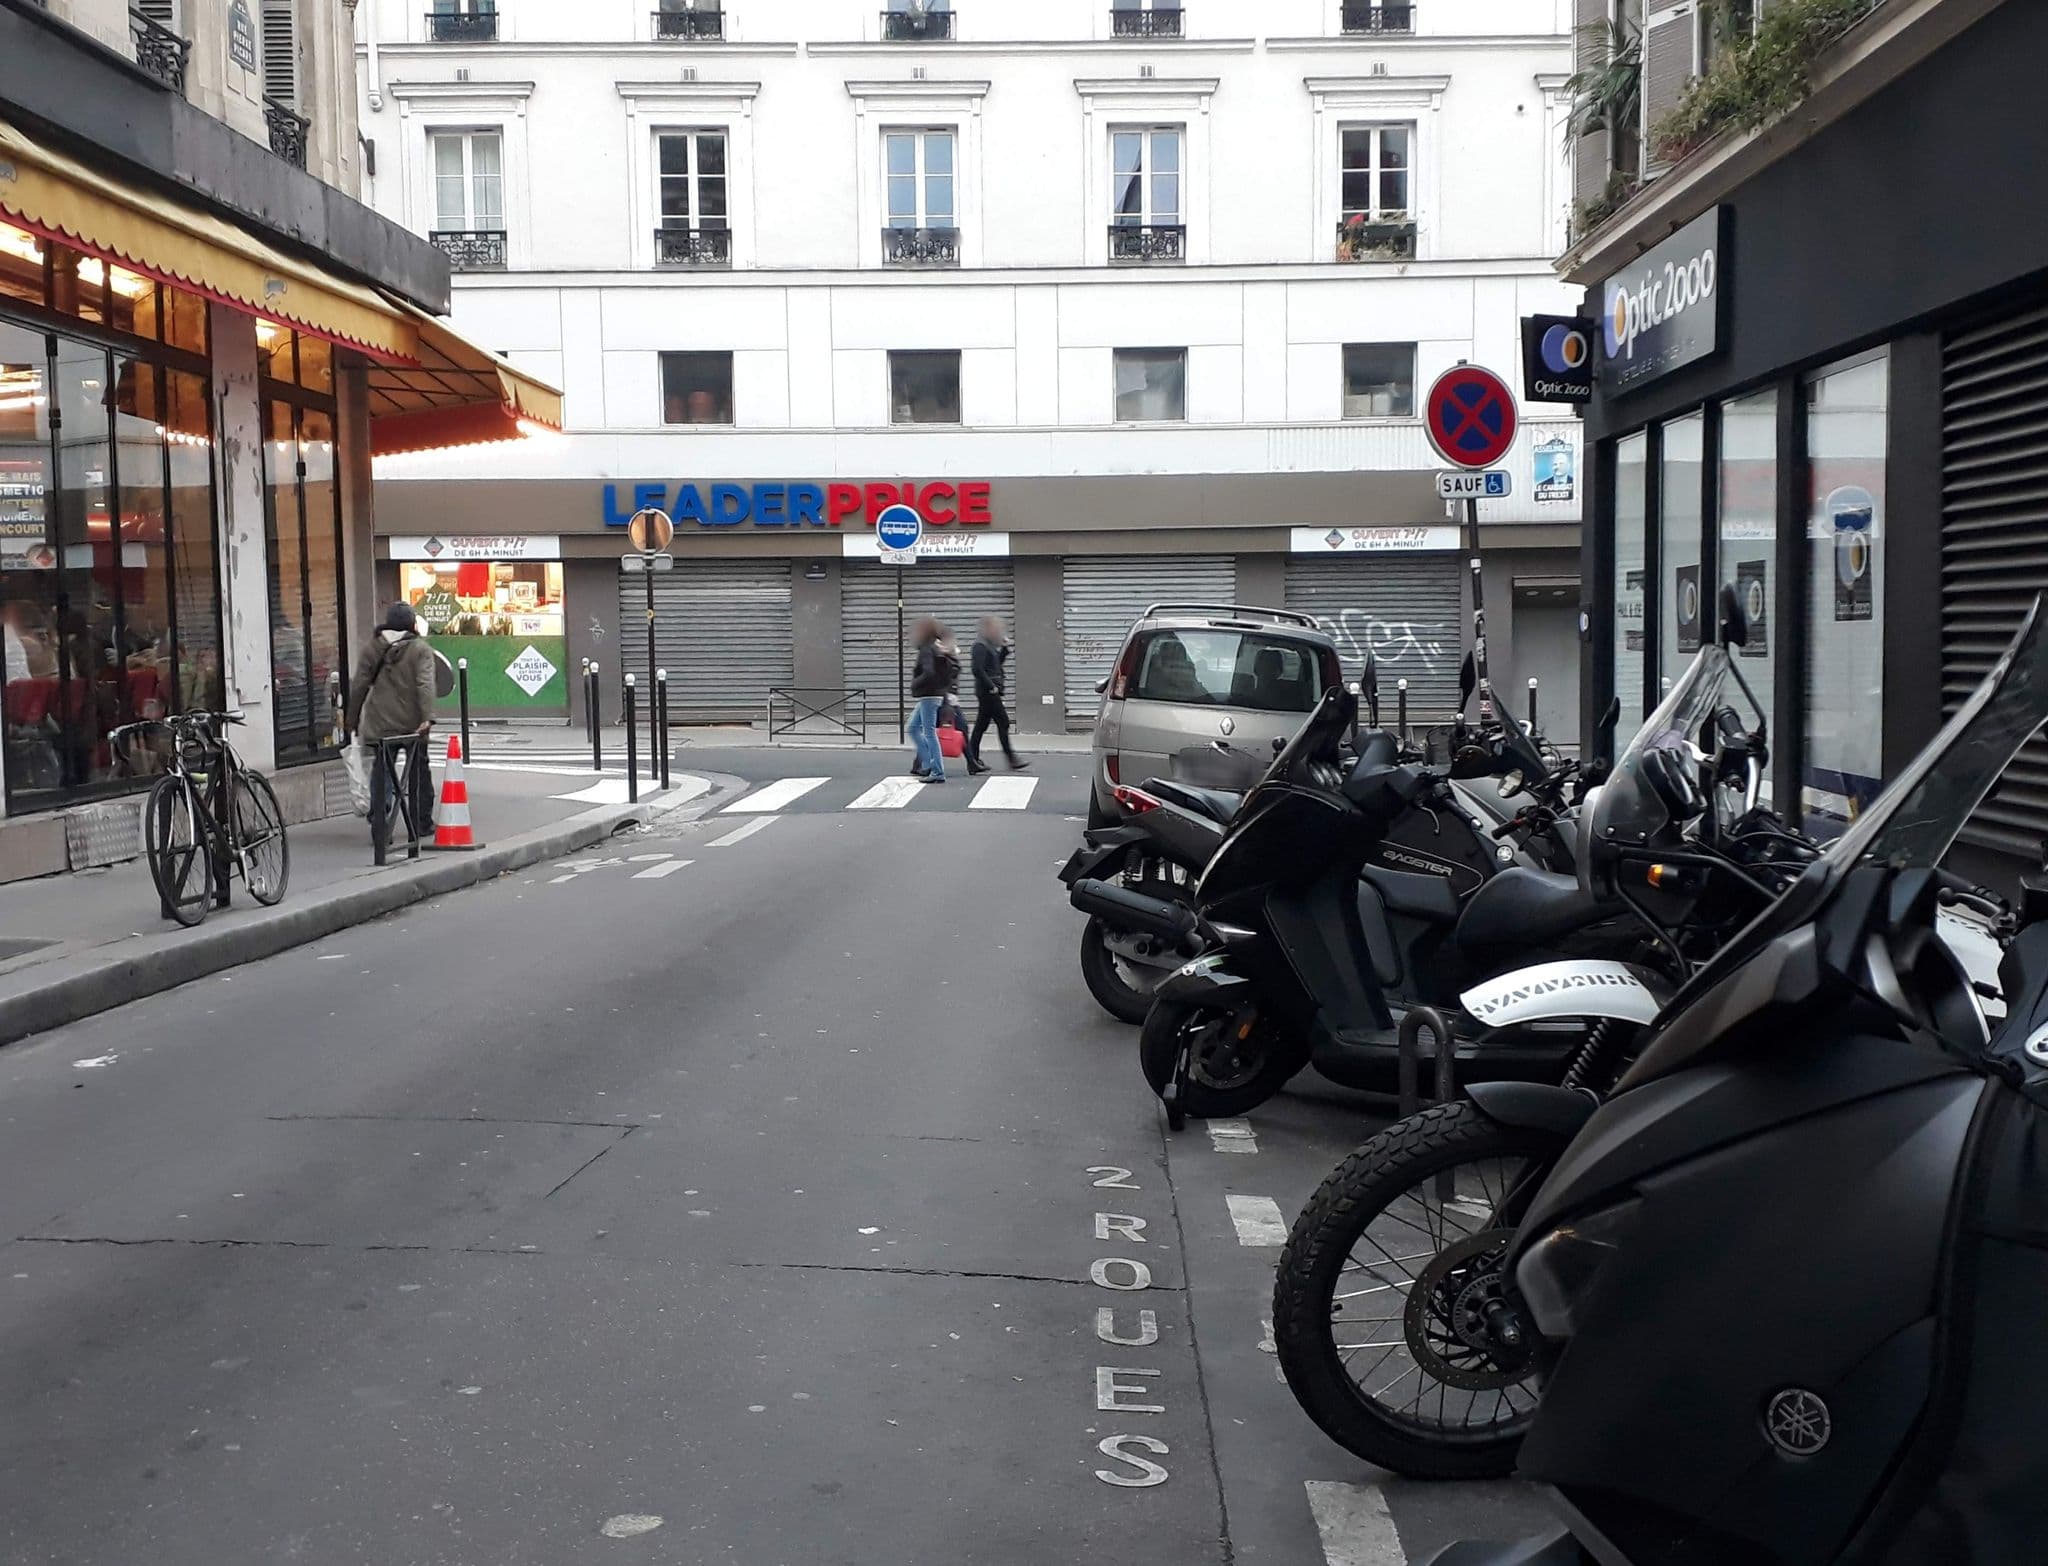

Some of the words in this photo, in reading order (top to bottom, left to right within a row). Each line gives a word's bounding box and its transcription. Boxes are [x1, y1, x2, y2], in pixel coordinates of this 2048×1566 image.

[1614, 270, 1663, 360] Optic
[1663, 249, 1716, 320] 2000
[1534, 380, 1564, 397] Optic
[1564, 382, 1590, 396] 2000
[1443, 478, 1483, 492] SAUF
[1351, 528, 1402, 540] OUVERT
[450, 536, 501, 549] OUVERT
[1354, 541, 1367, 549] DE
[1393, 540, 1424, 548] MINUIT
[454, 549, 466, 557] DE
[469, 549, 481, 557] 6H
[492, 548, 525, 557] MINUIT
[920, 546, 932, 554] 6H
[513, 662, 548, 670] PLAISIR
[1383, 850, 1453, 876] BAGSTER
[1086, 1166, 1141, 1190] 2
[1090, 1212, 1170, 1487] ROUES
